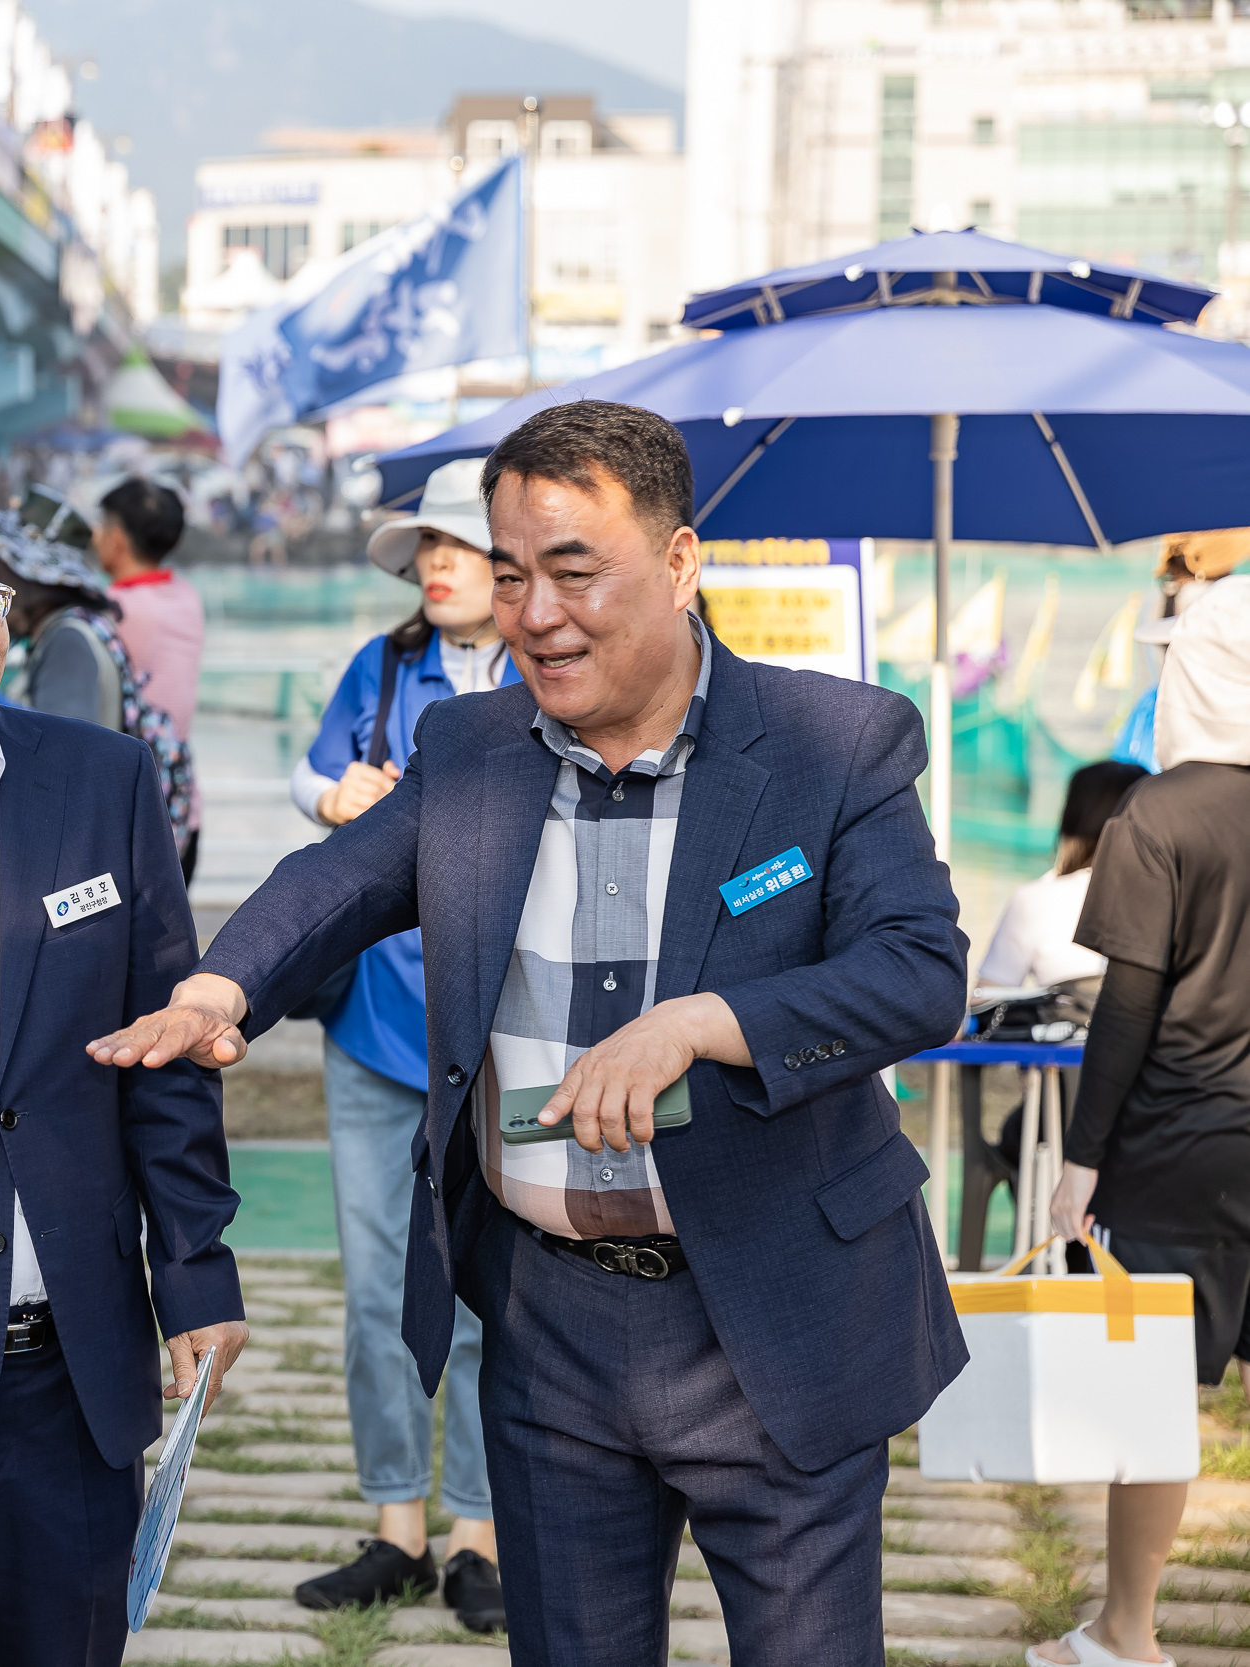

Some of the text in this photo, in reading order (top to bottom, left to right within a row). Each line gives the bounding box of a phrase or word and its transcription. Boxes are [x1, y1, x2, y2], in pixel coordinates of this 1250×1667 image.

[732, 863, 807, 908] 비서실장 위등환
[79, 896, 108, 913] 광진구청장
